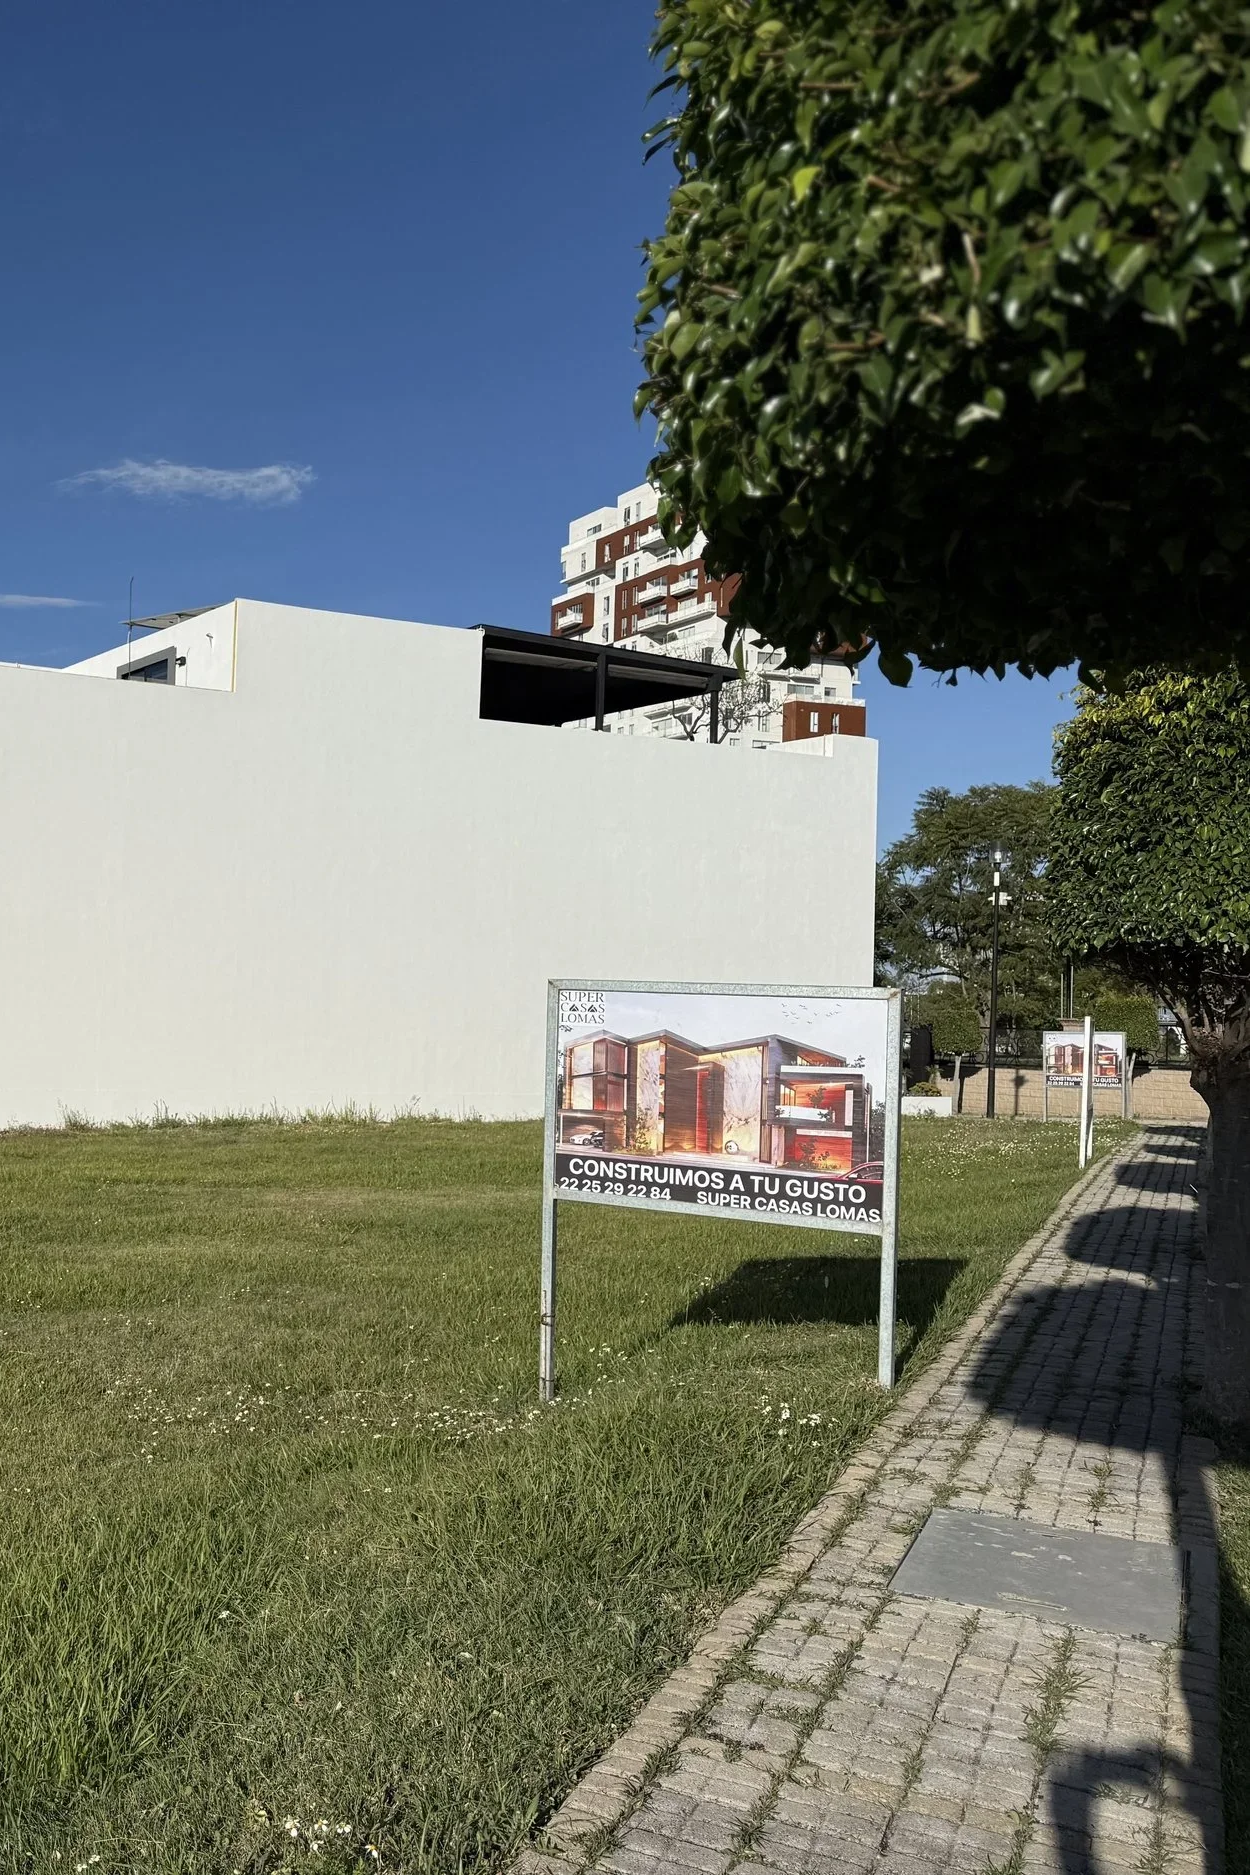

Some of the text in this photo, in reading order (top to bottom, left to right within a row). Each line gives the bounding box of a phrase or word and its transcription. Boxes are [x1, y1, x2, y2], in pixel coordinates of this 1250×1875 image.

[560, 991, 604, 1003] SUPER
[560, 1002, 605, 1014] CASAS
[561, 1012, 605, 1025] LOMAS
[569, 1157, 866, 1204] CONSTRUIMOS A TU GUSTO
[560, 1177, 881, 1223] 22 25 29 22 84 SUPER CASAS LOMAS
